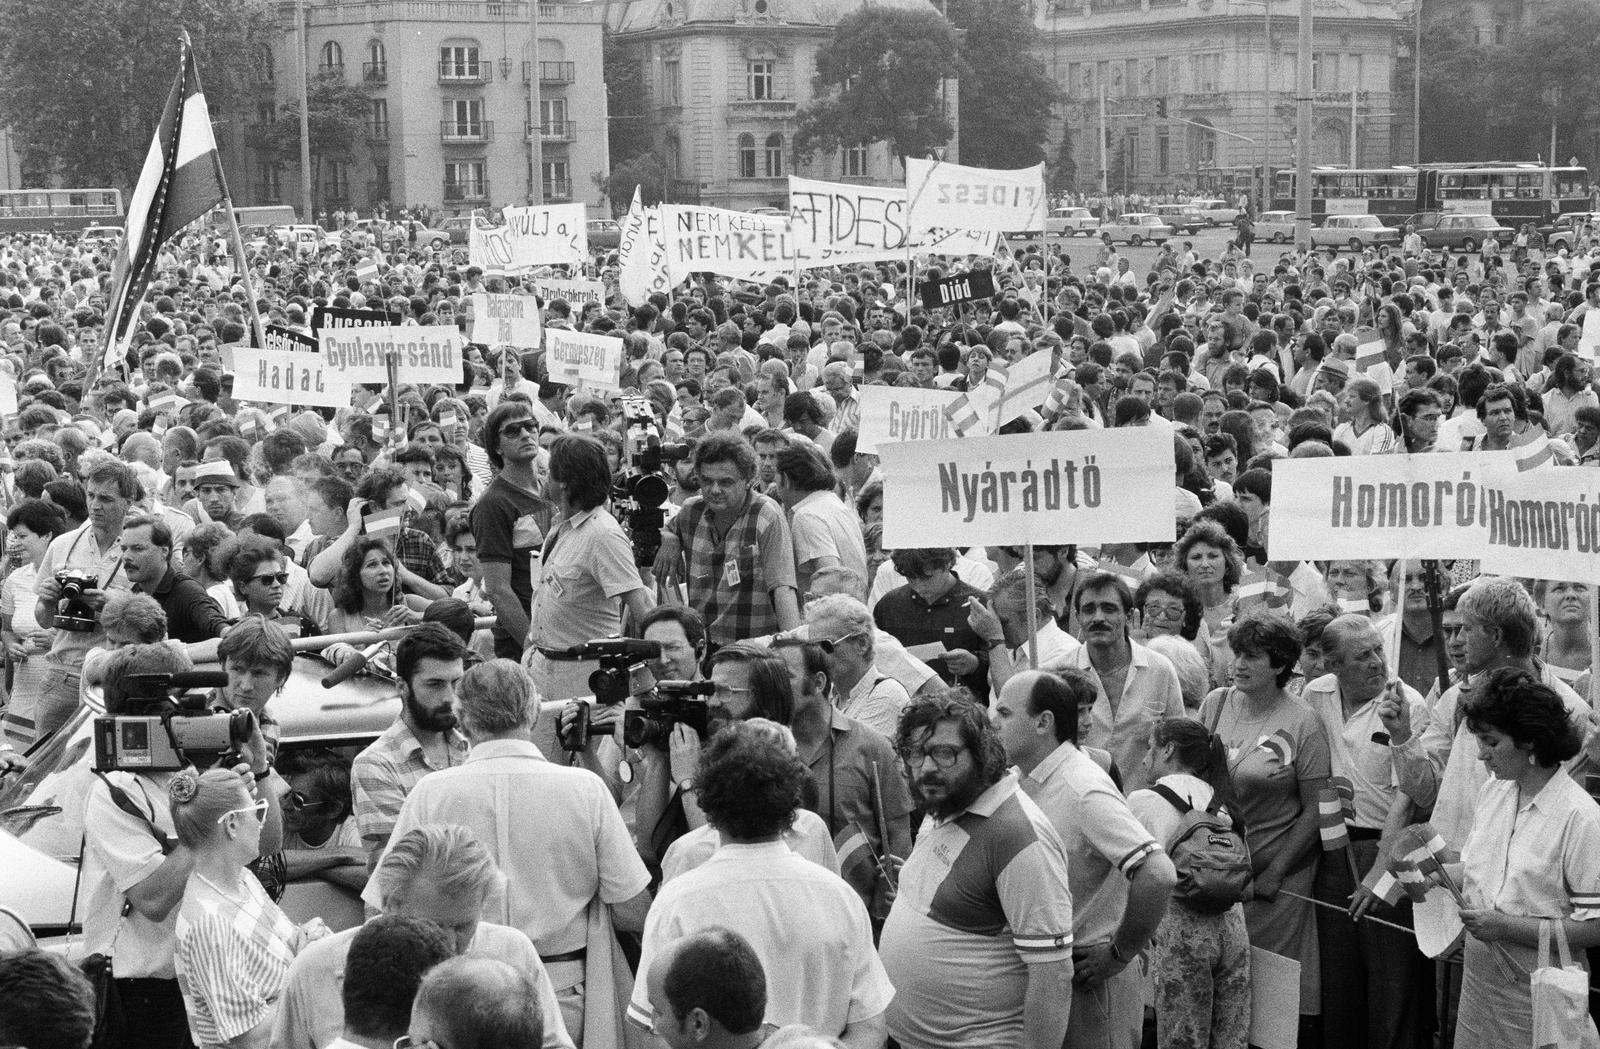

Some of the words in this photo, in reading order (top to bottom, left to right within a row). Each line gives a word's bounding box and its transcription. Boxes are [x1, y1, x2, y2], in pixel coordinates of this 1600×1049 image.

[677, 211, 721, 232] NEM
[939, 278, 972, 304] Diód
[325, 335, 453, 371] Gyulavarsánd
[938, 455, 1101, 523] Nyárádtő
[1331, 471, 1487, 528] Homoró
